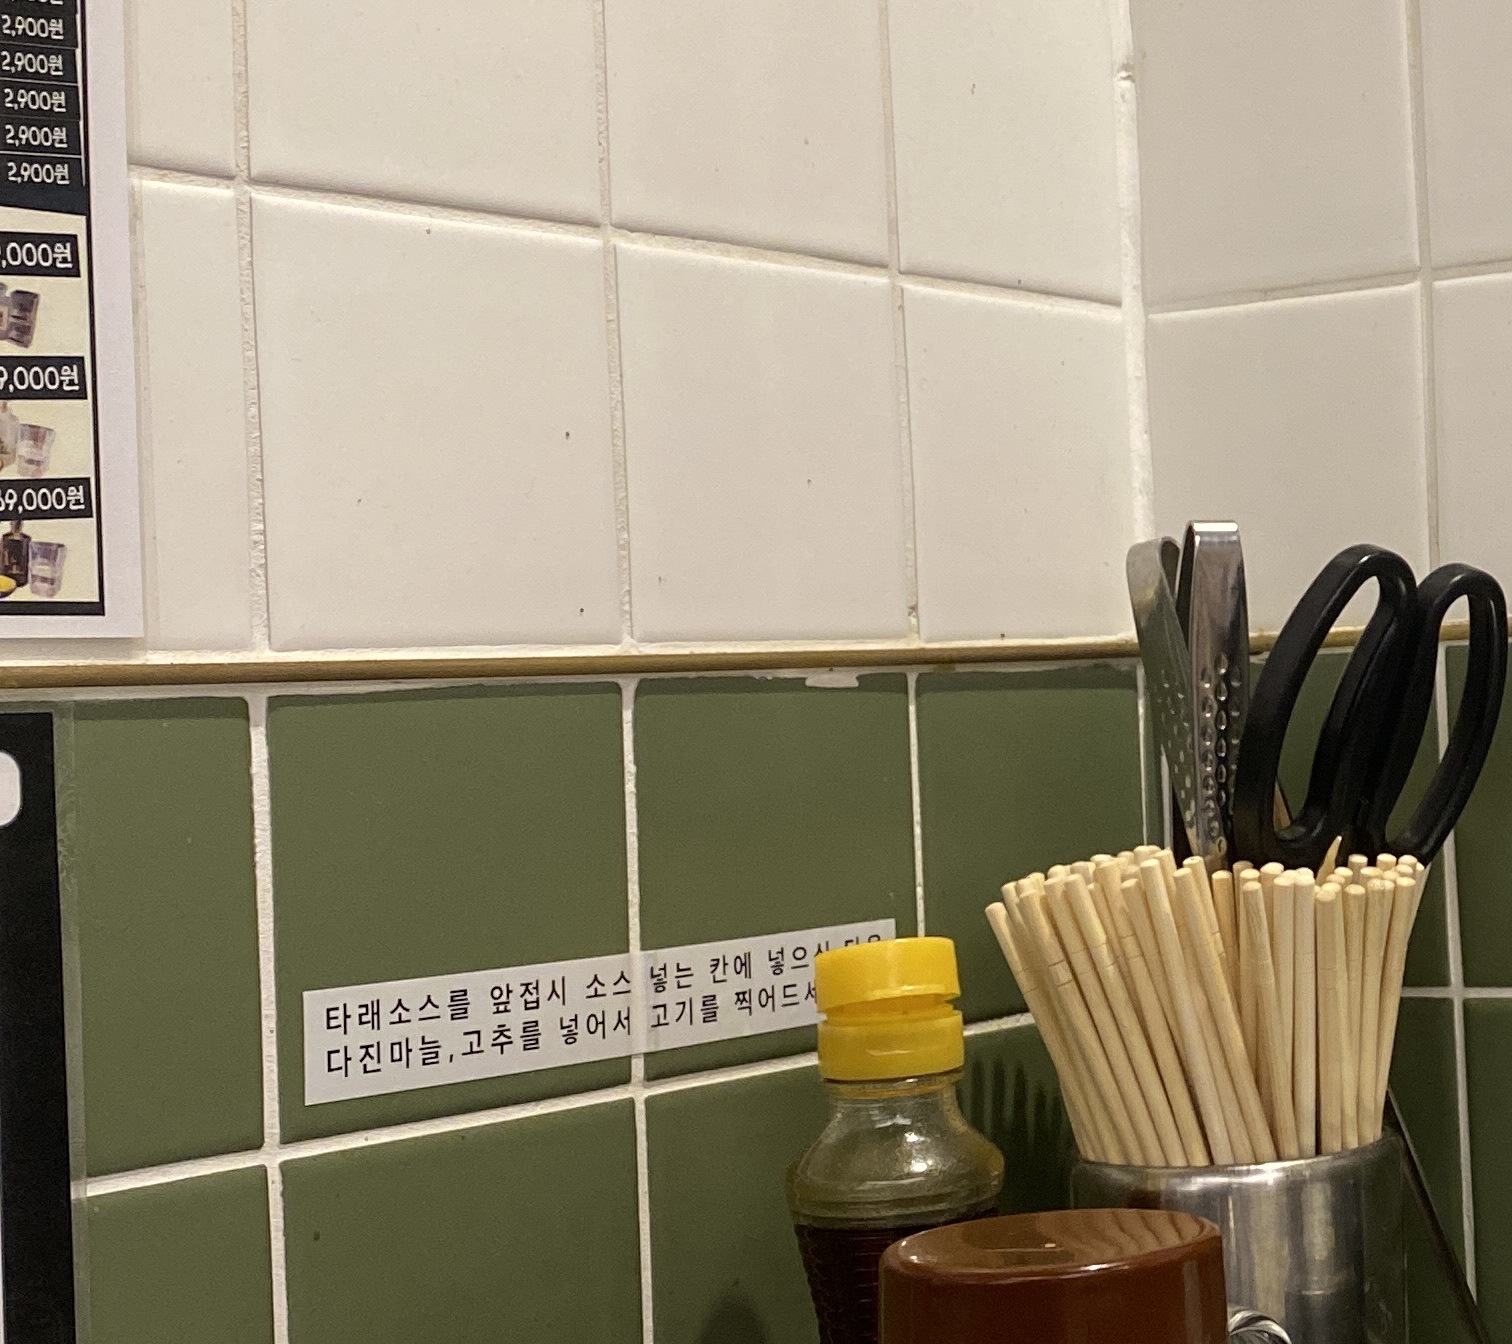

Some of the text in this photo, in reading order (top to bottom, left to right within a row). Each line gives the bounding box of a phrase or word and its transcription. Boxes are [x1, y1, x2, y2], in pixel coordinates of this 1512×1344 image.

[0, 14, 65, 40] 2,900원
[0, 50, 64, 76] 2,900원
[3, 88, 67, 113] 2,900원
[4, 124, 68, 148] 2,900원
[7, 161, 70, 185] 2,900원
[0, 242, 73, 269] ,000원
[325, 988, 471, 1036] 타래소스를
[490, 975, 567, 1015] 앞접시
[585, 969, 633, 1000] 소스
[650, 962, 694, 994] 넣는
[710, 951, 752, 984] 칸에
[326, 1019, 543, 1078] 다진마늘,고추를
[559, 1006, 632, 1046] 넣어서
[651, 994, 719, 1029] 고기를
